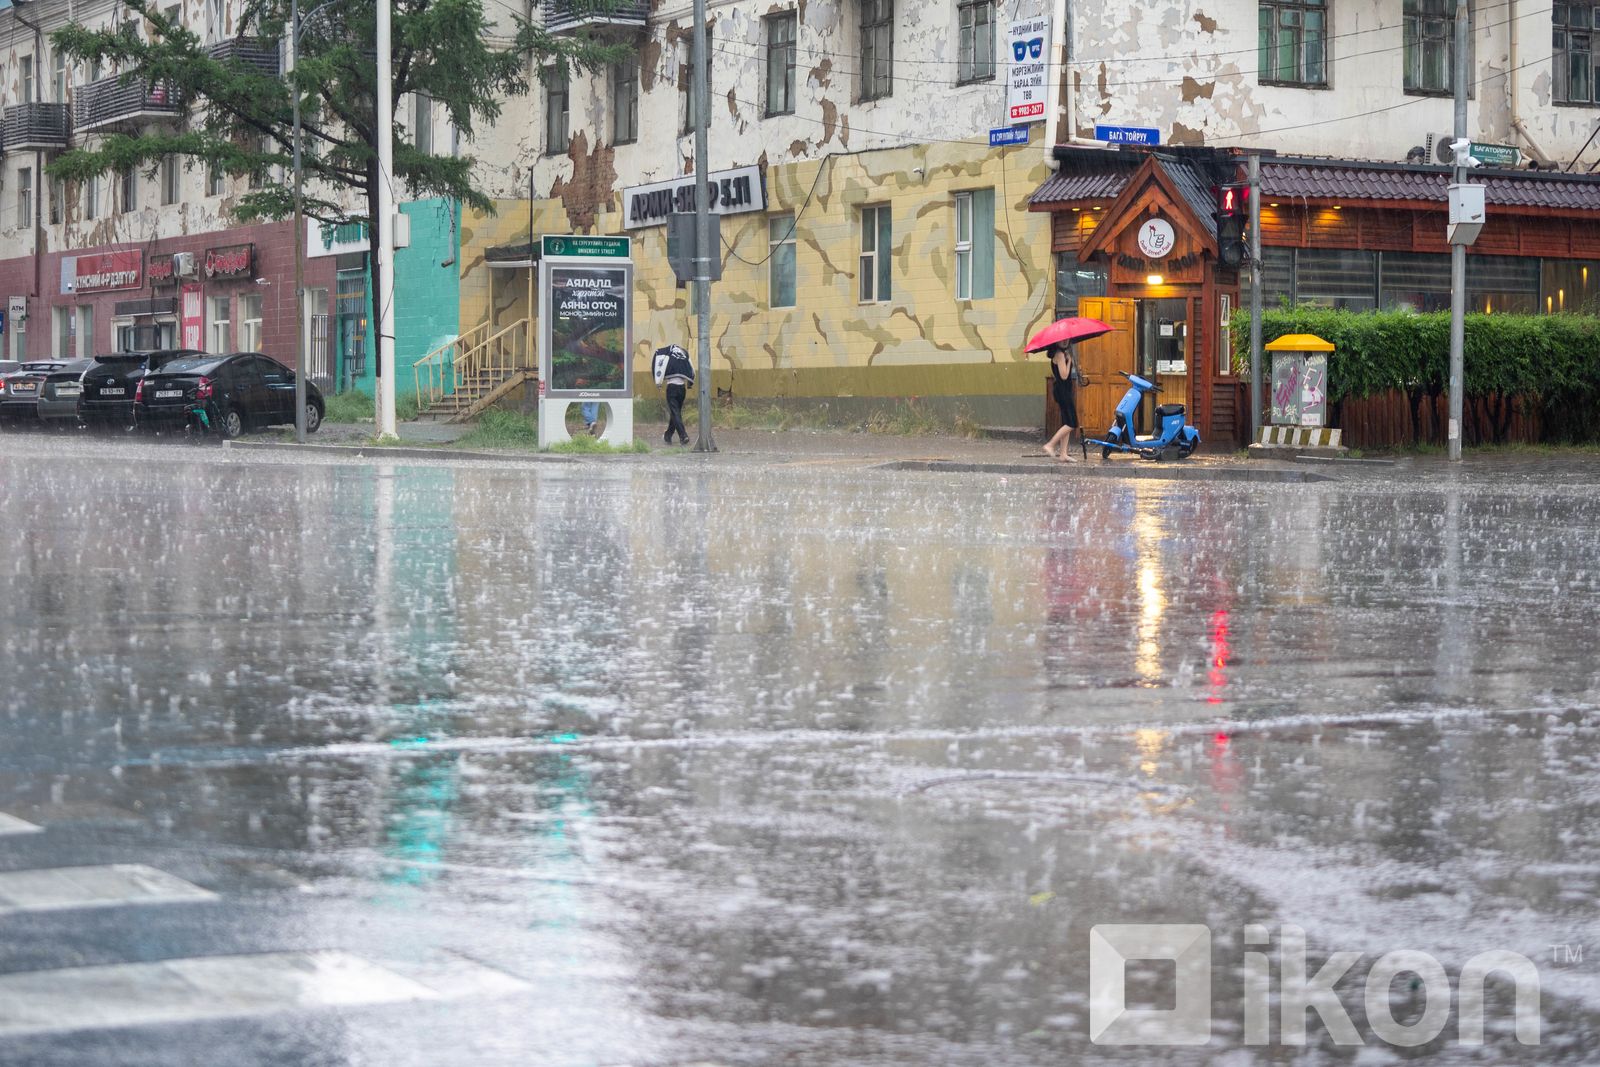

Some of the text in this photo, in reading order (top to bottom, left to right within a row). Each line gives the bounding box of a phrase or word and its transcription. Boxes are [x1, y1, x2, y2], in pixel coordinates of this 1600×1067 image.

[1108, 131, 1123, 140] БАГА
[566, 278, 612, 288] АЯЛАЛД
[560, 301, 617, 310] АЯНЫ ОТОЧ
